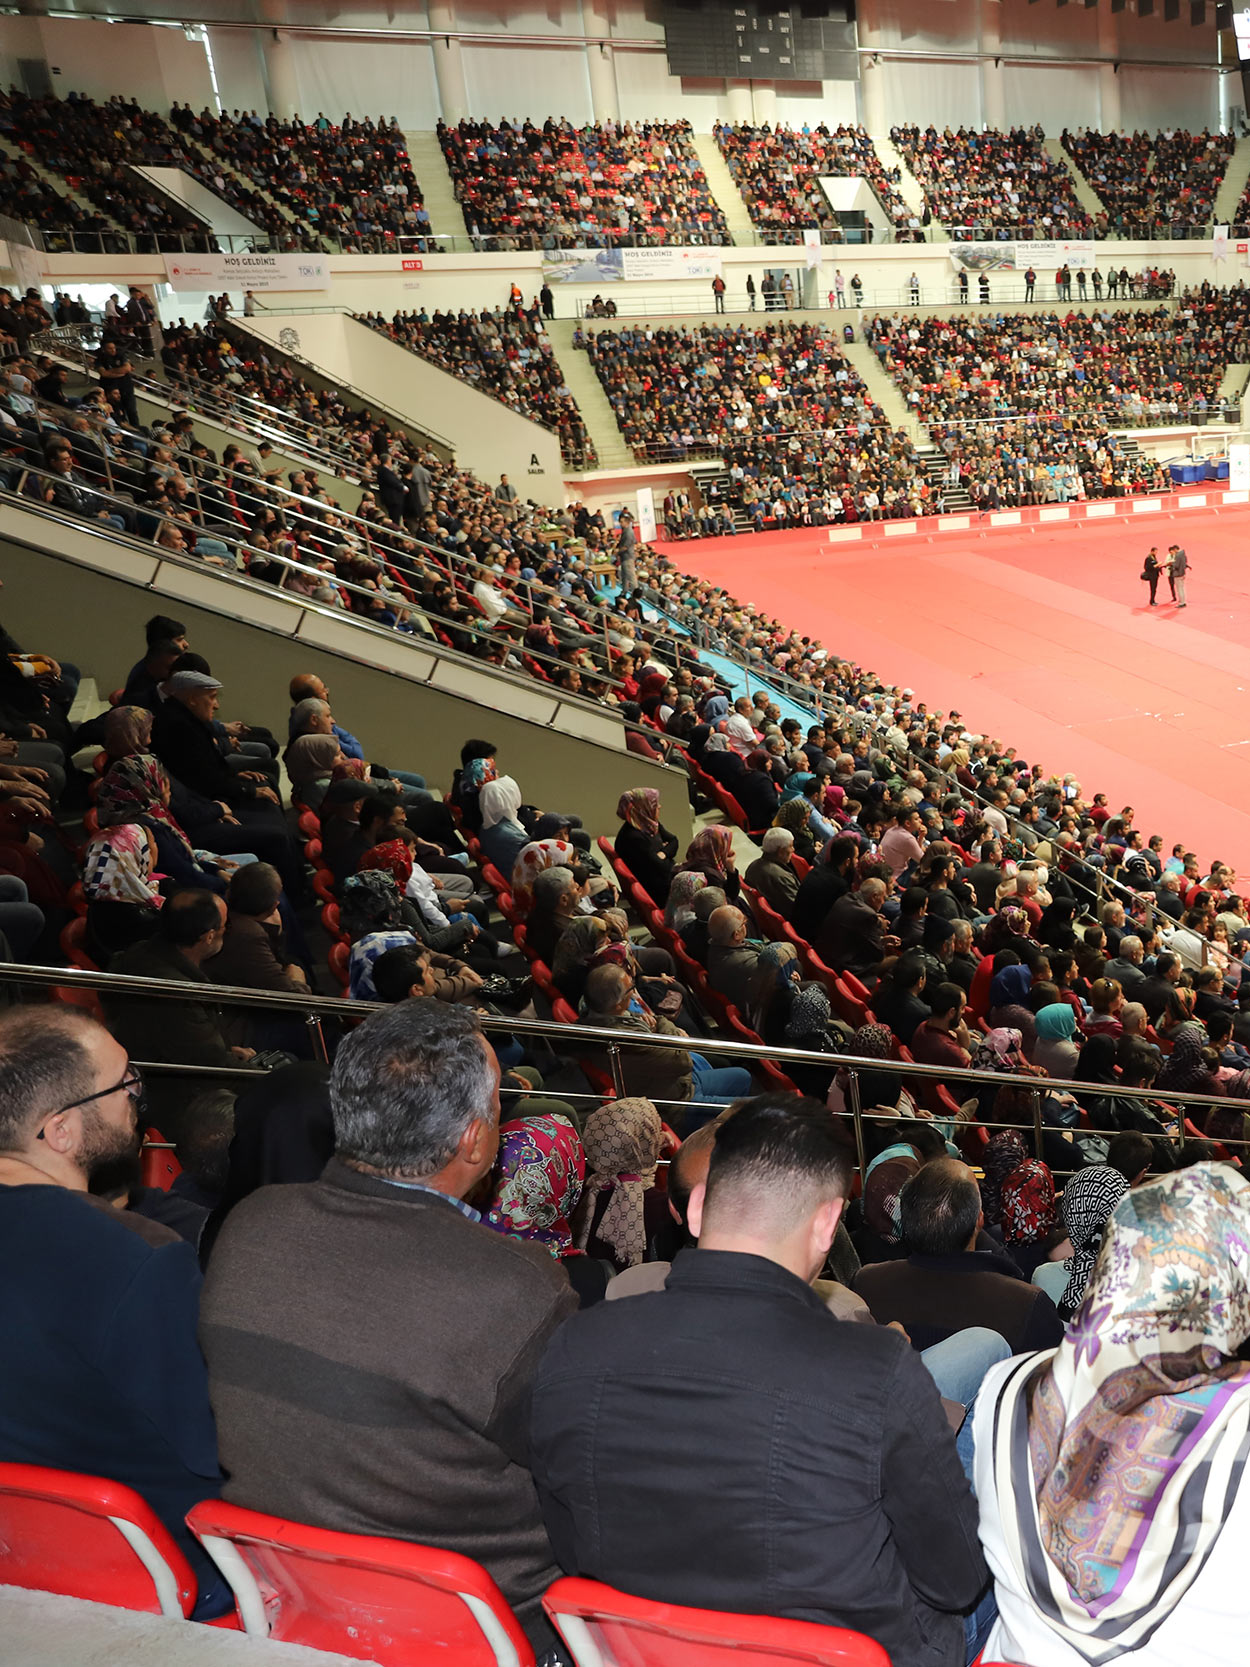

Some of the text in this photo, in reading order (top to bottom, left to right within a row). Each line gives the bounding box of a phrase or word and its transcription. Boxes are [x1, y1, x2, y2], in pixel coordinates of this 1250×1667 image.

[224, 257, 277, 267] HOŞ GELDİNİZ
[530, 453, 540, 466] A
